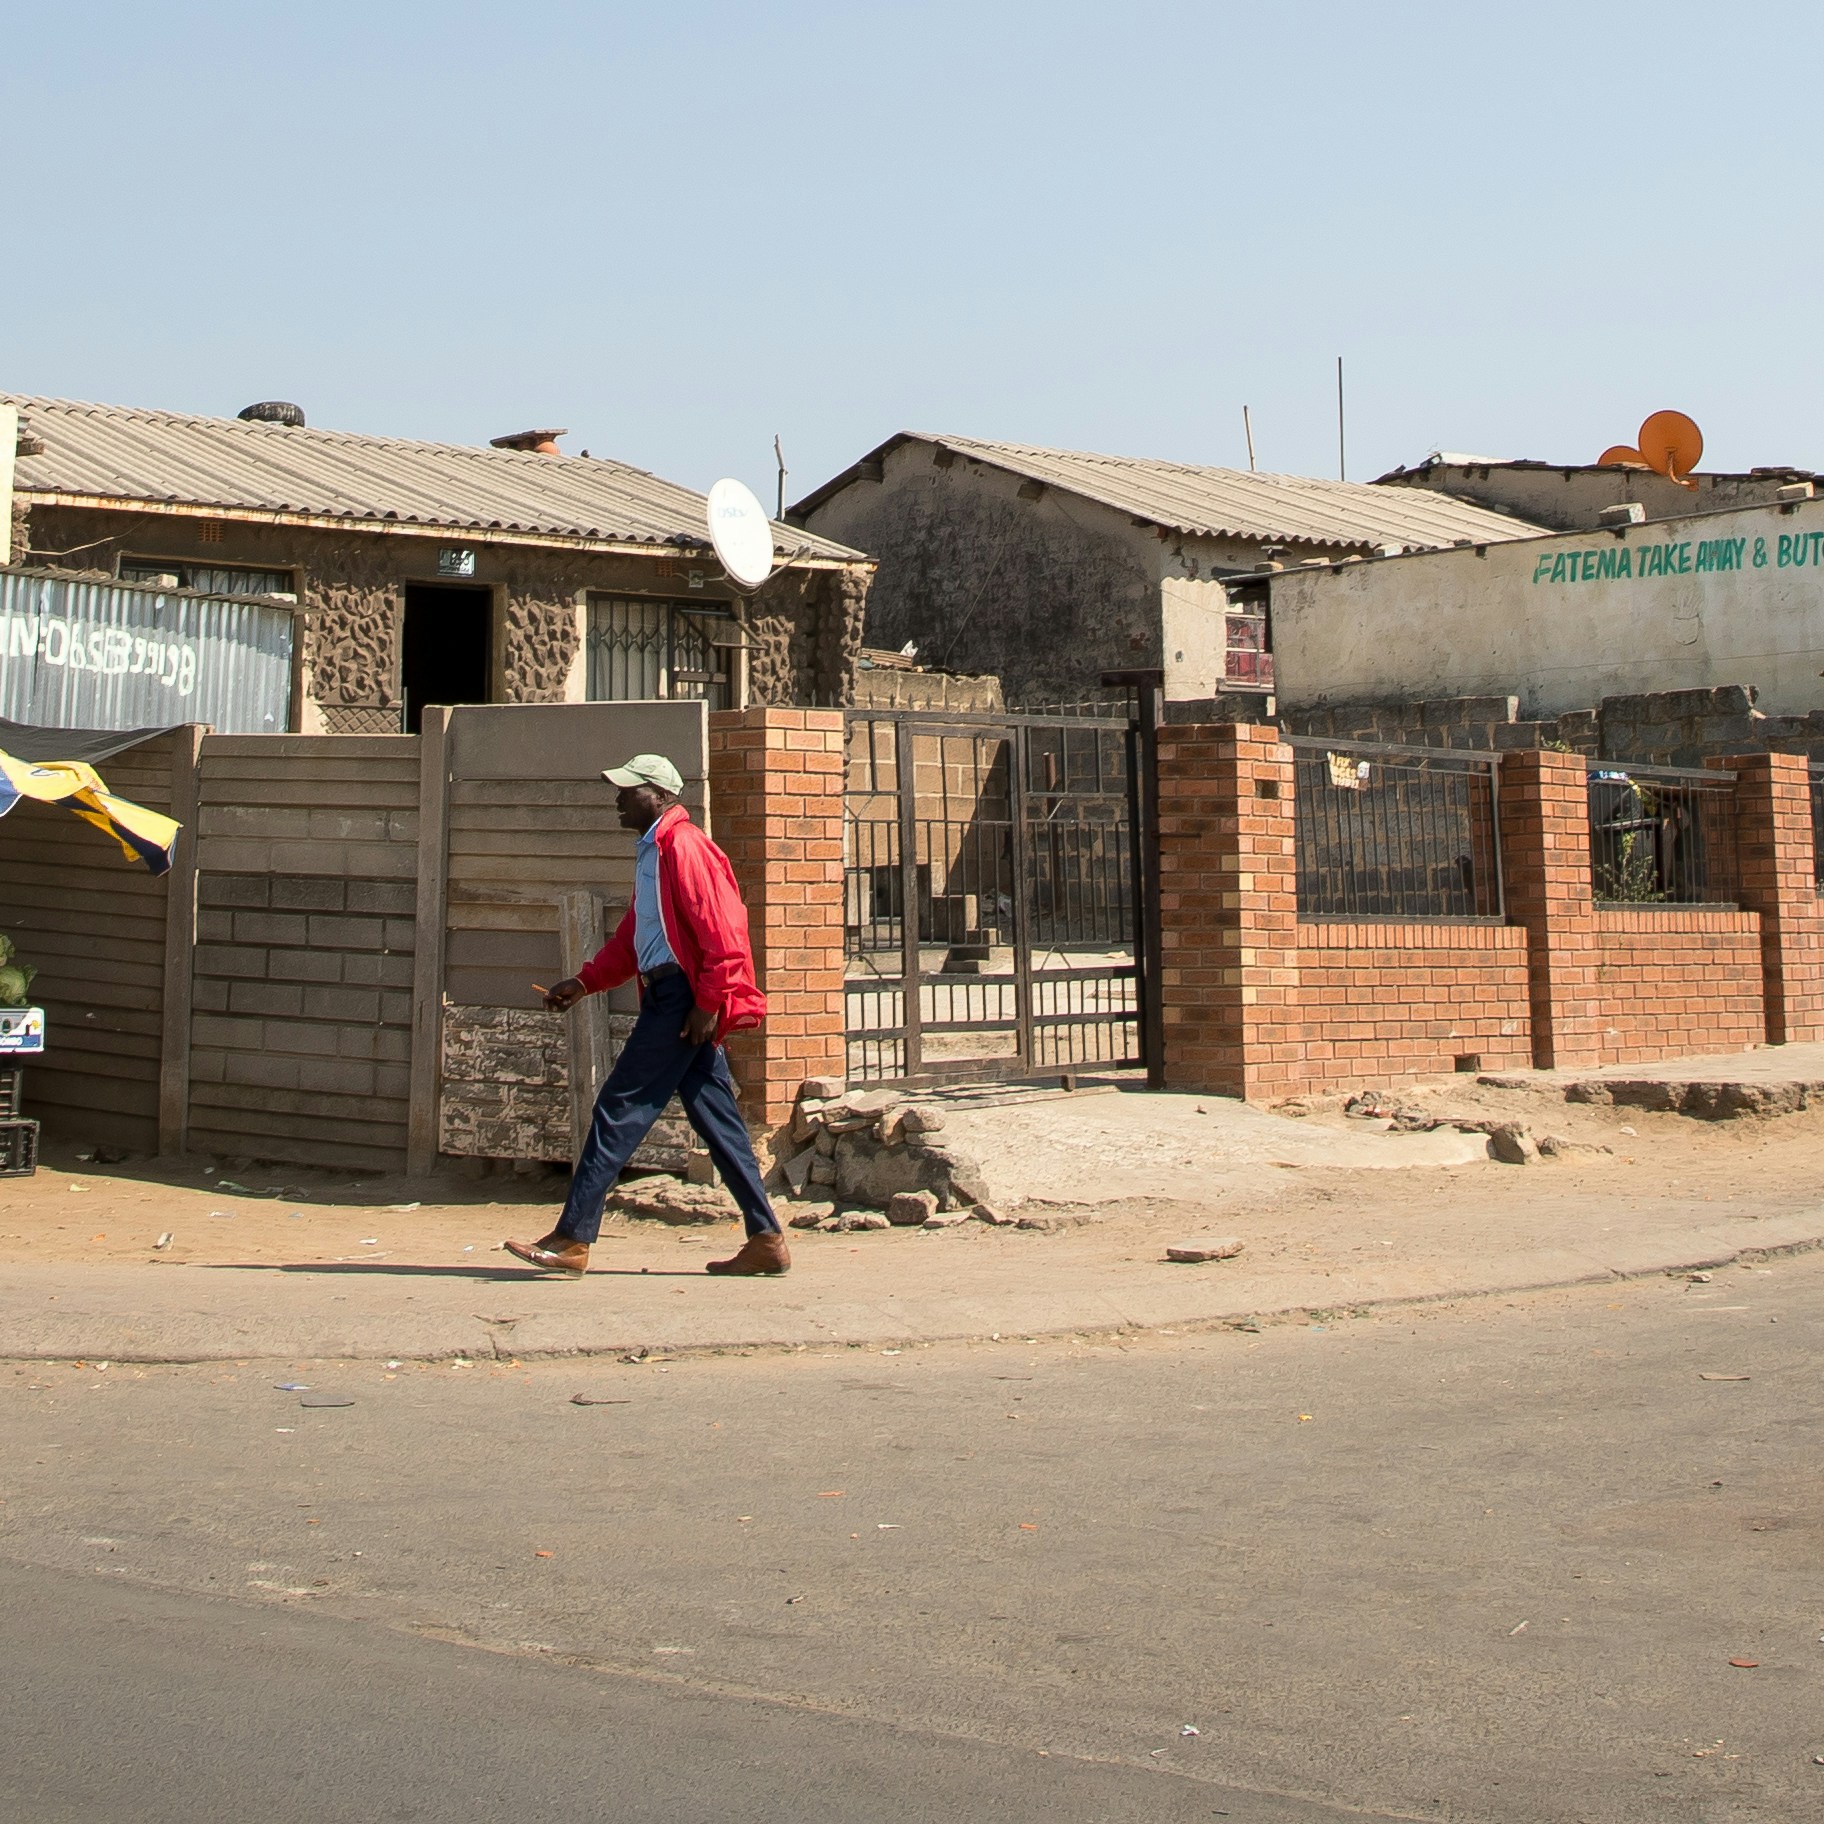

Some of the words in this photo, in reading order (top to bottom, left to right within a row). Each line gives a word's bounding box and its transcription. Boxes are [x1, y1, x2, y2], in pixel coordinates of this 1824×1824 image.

[1532, 547, 1631, 584] FATEMA
[1637, 541, 1692, 577] TAKE
[1694, 537, 1746, 572] AWAY
[1752, 537, 1768, 568] &
